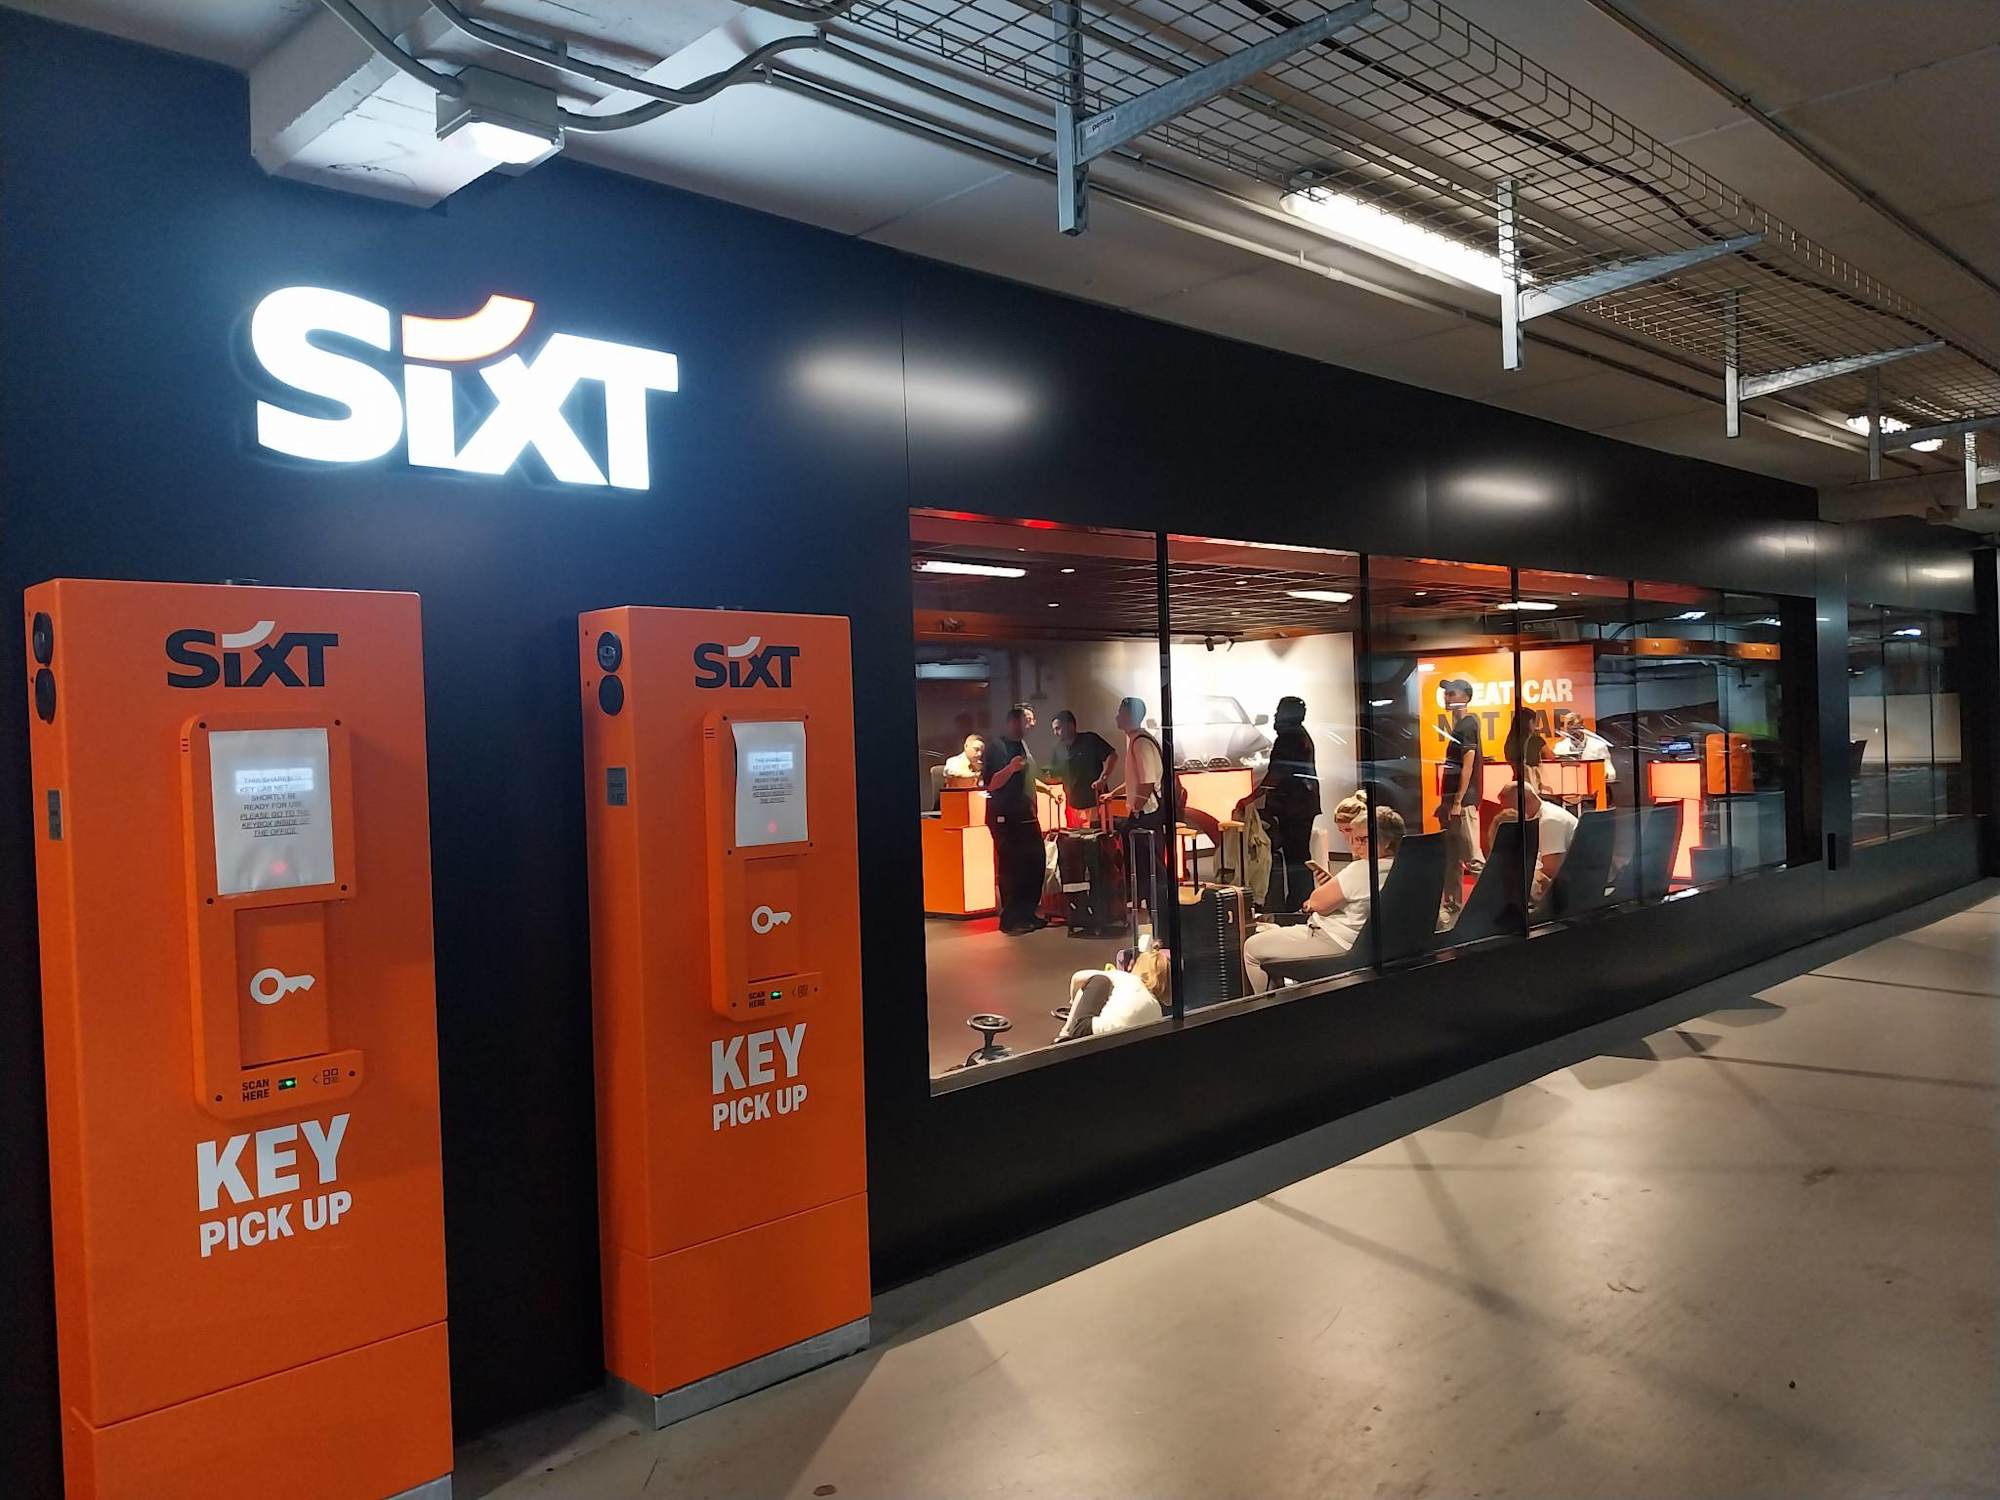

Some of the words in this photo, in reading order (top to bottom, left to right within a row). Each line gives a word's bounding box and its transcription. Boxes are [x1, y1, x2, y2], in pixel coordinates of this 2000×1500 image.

[1522, 678, 1574, 704] CAR
[243, 802, 269, 811] READY
[711, 1022, 807, 1095] KEY
[242, 1078, 270, 1091] SCAN
[242, 1088, 270, 1102] HERE
[713, 1092, 771, 1131] PICK
[776, 1084, 808, 1115] UP
[196, 1113, 351, 1212] KEY
[200, 1203, 295, 1258] PICK
[303, 1191, 353, 1232] UP
